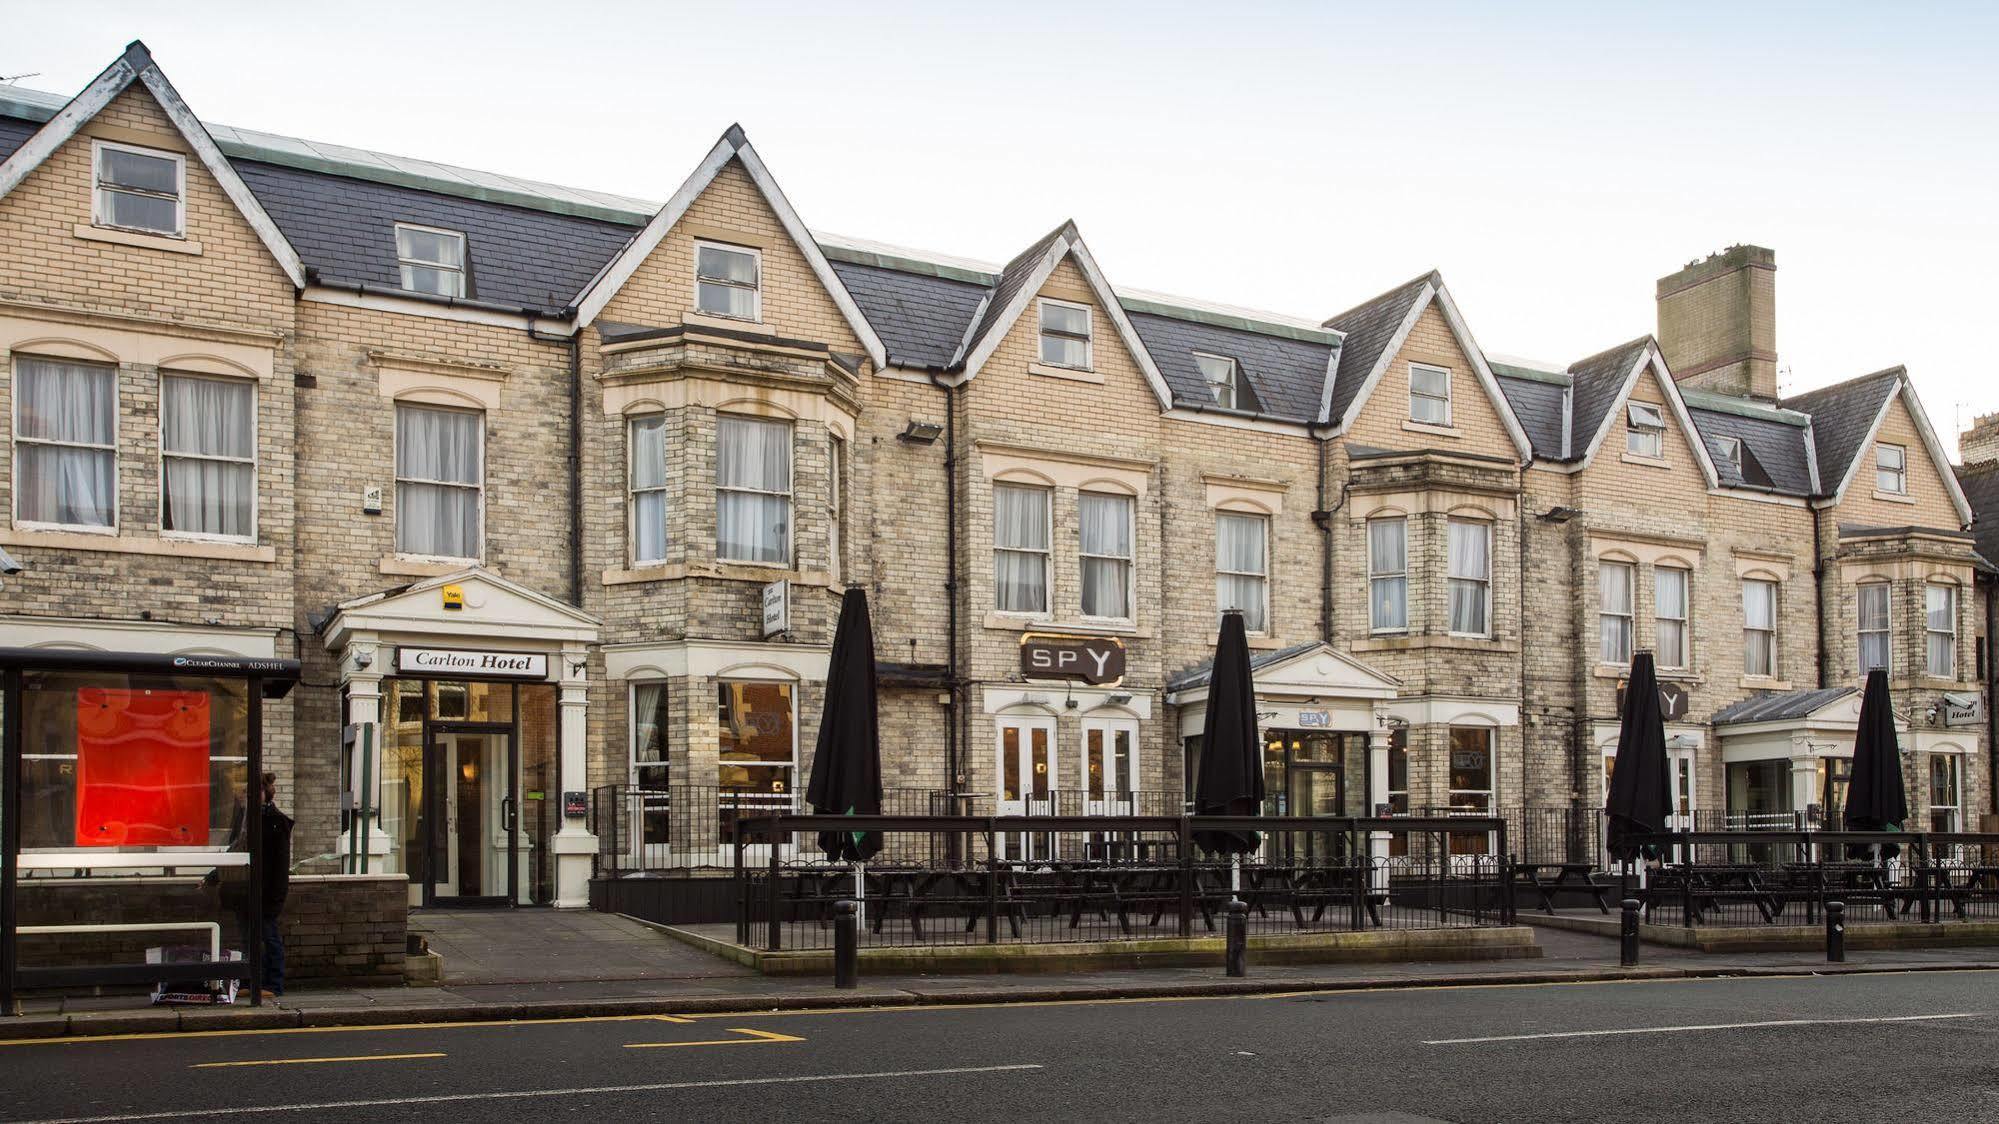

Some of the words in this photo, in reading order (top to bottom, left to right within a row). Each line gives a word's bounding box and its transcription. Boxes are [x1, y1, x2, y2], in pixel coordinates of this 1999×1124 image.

[248, 662, 285, 671] ADSHEL
[416, 652, 475, 667] Carlton
[480, 654, 532, 670] Hotel
[1032, 647, 1111, 677] SPY
[1952, 710, 1975, 719] Hotel
